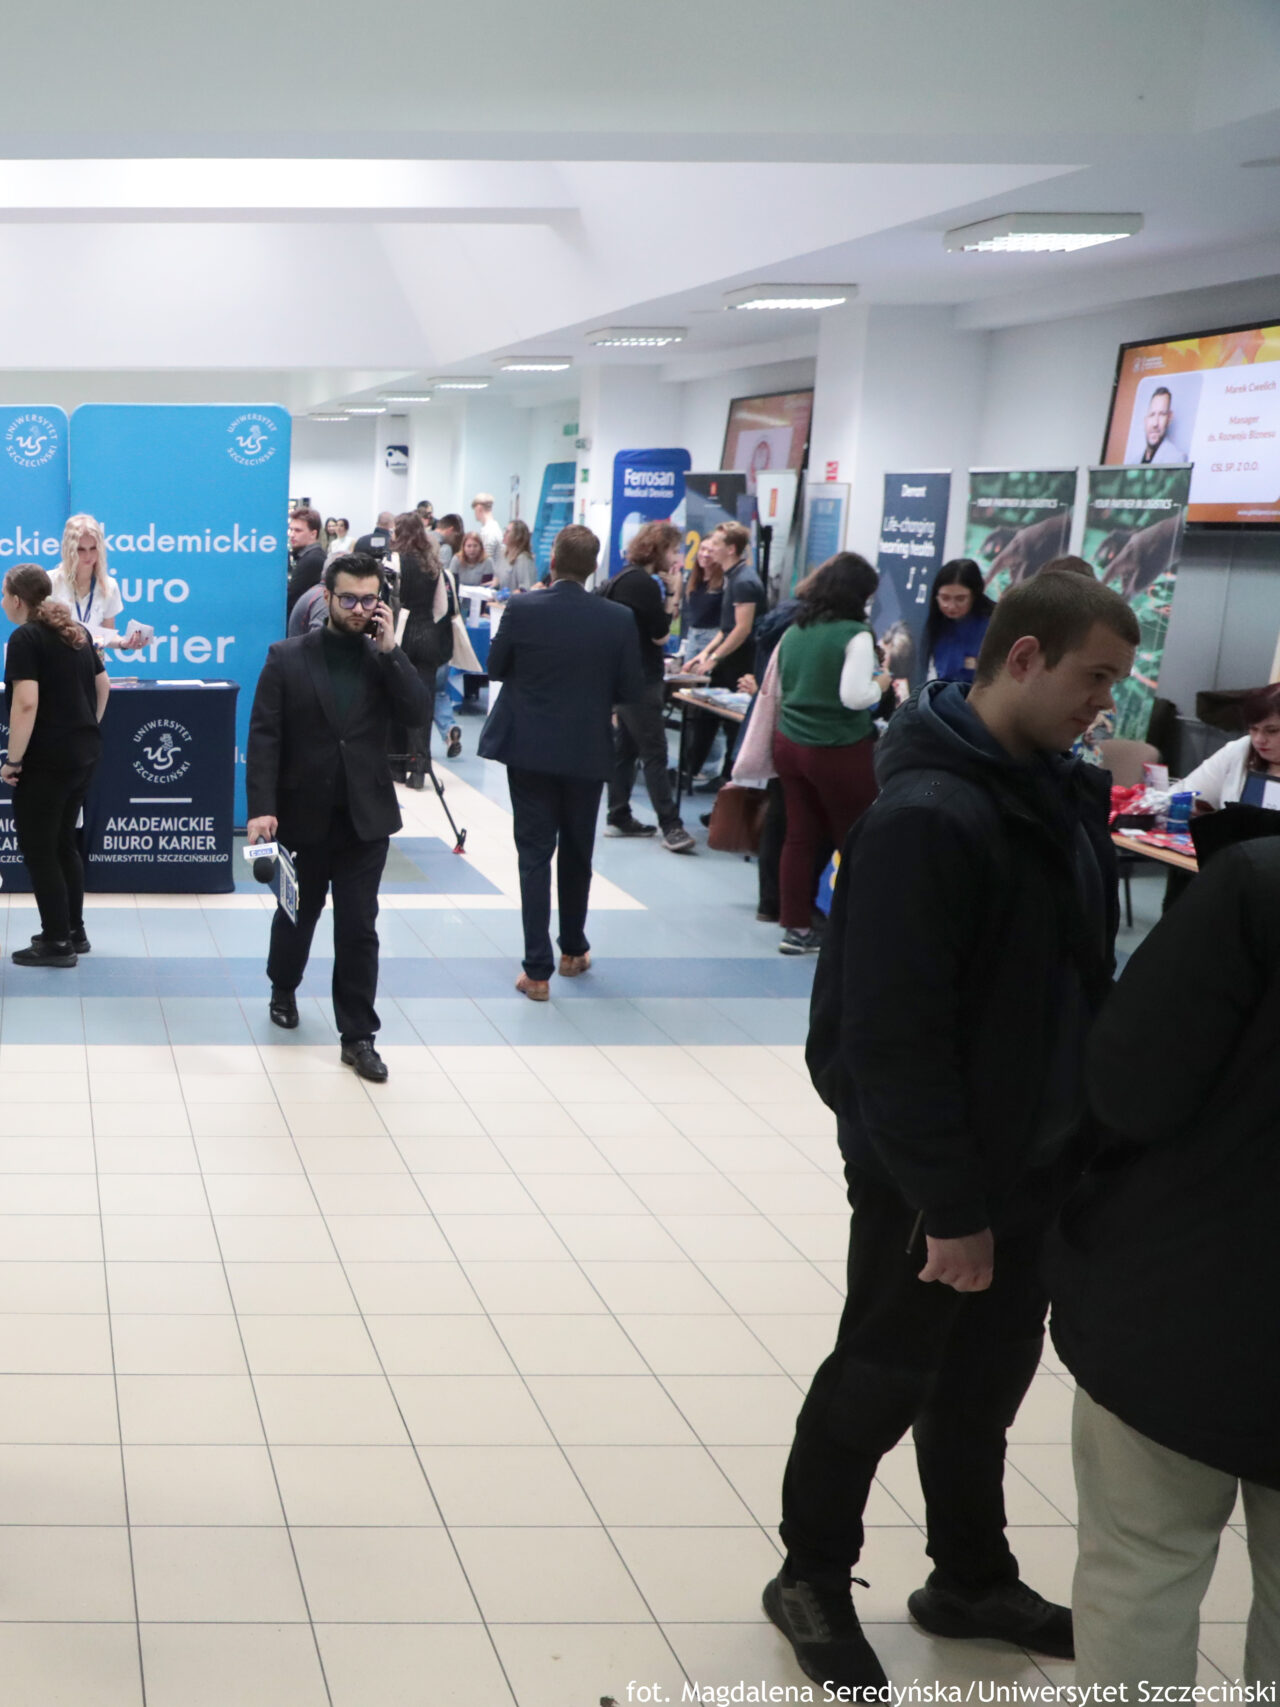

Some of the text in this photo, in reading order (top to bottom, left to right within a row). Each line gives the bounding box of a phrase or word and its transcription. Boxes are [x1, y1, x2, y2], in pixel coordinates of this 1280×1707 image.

[5, 414, 58, 440] UNIWERSYTET
[227, 413, 277, 432] UNIWERSYTET
[624, 468, 675, 486] Ferrosan
[99, 522, 278, 553] kademickie
[133, 719, 192, 743] UNIWERSYTET
[133, 760, 191, 784] SZCZECIŃSKI
[106, 816, 215, 832] AKADEMICKIE
[103, 836, 216, 850] BIURO KARIER
[88, 852, 229, 863] UNIWERSYTETU SZCZECIŃSKIEGO
